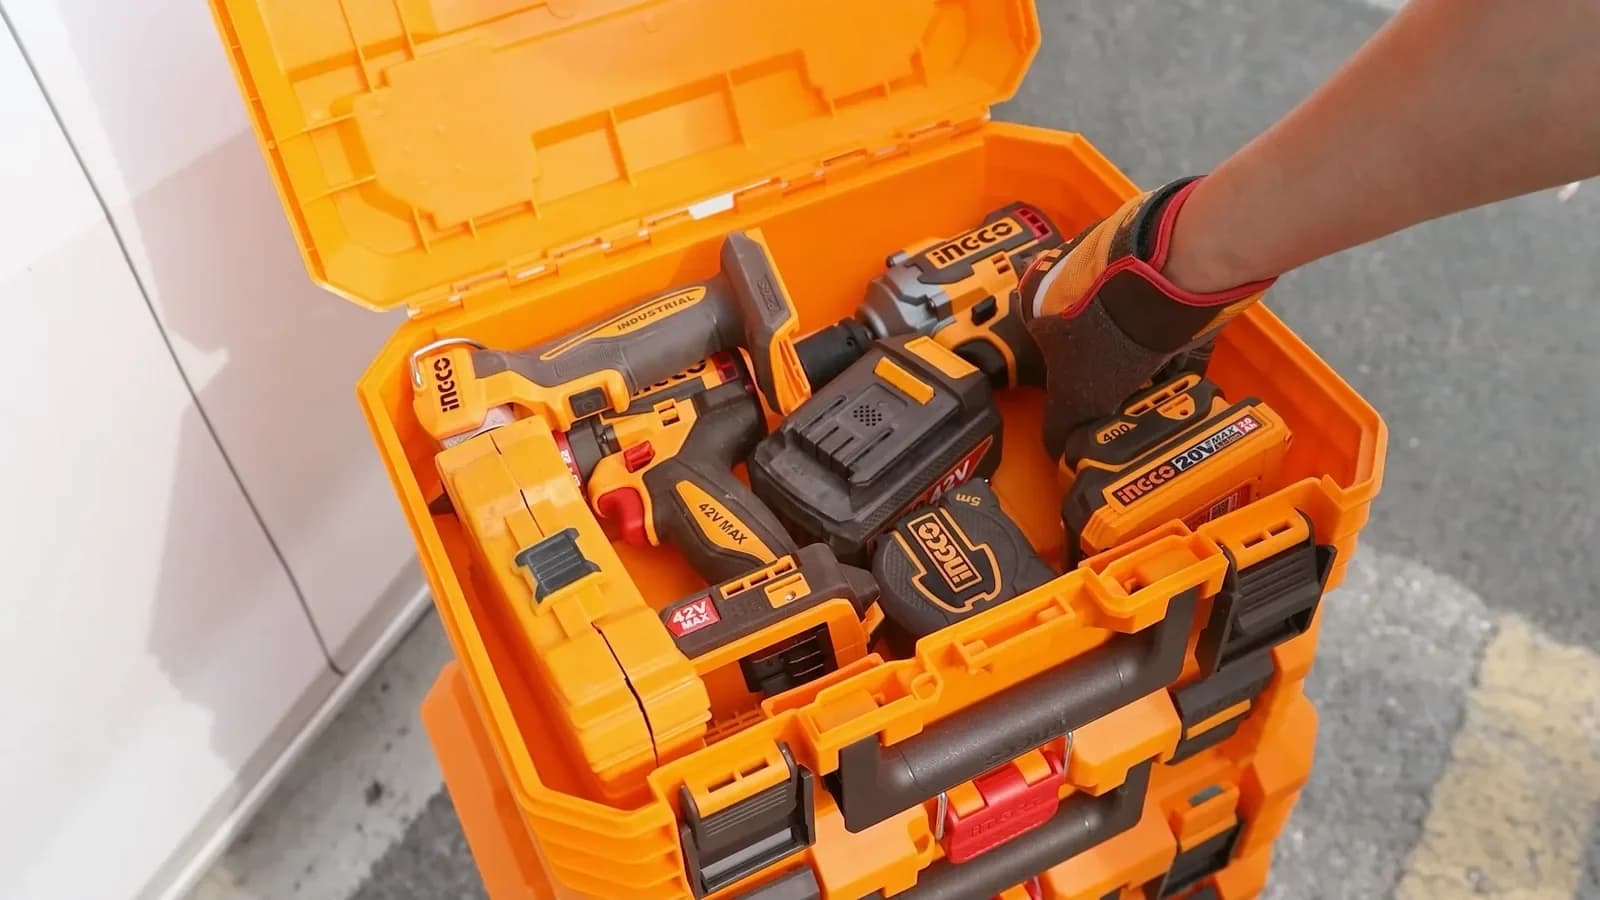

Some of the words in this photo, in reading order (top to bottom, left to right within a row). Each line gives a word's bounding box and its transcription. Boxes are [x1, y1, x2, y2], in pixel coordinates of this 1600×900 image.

[617, 294, 695, 331] INDUSTRIAL
[1103, 423, 1130, 442] 400
[1212, 426, 1236, 445] MAX
[1175, 439, 1217, 470] 20V
[955, 493, 982, 507] 5m
[699, 503, 723, 522] 42V
[719, 521, 748, 544] MAX
[672, 601, 707, 623] 42V
[680, 613, 710, 630] MAX
